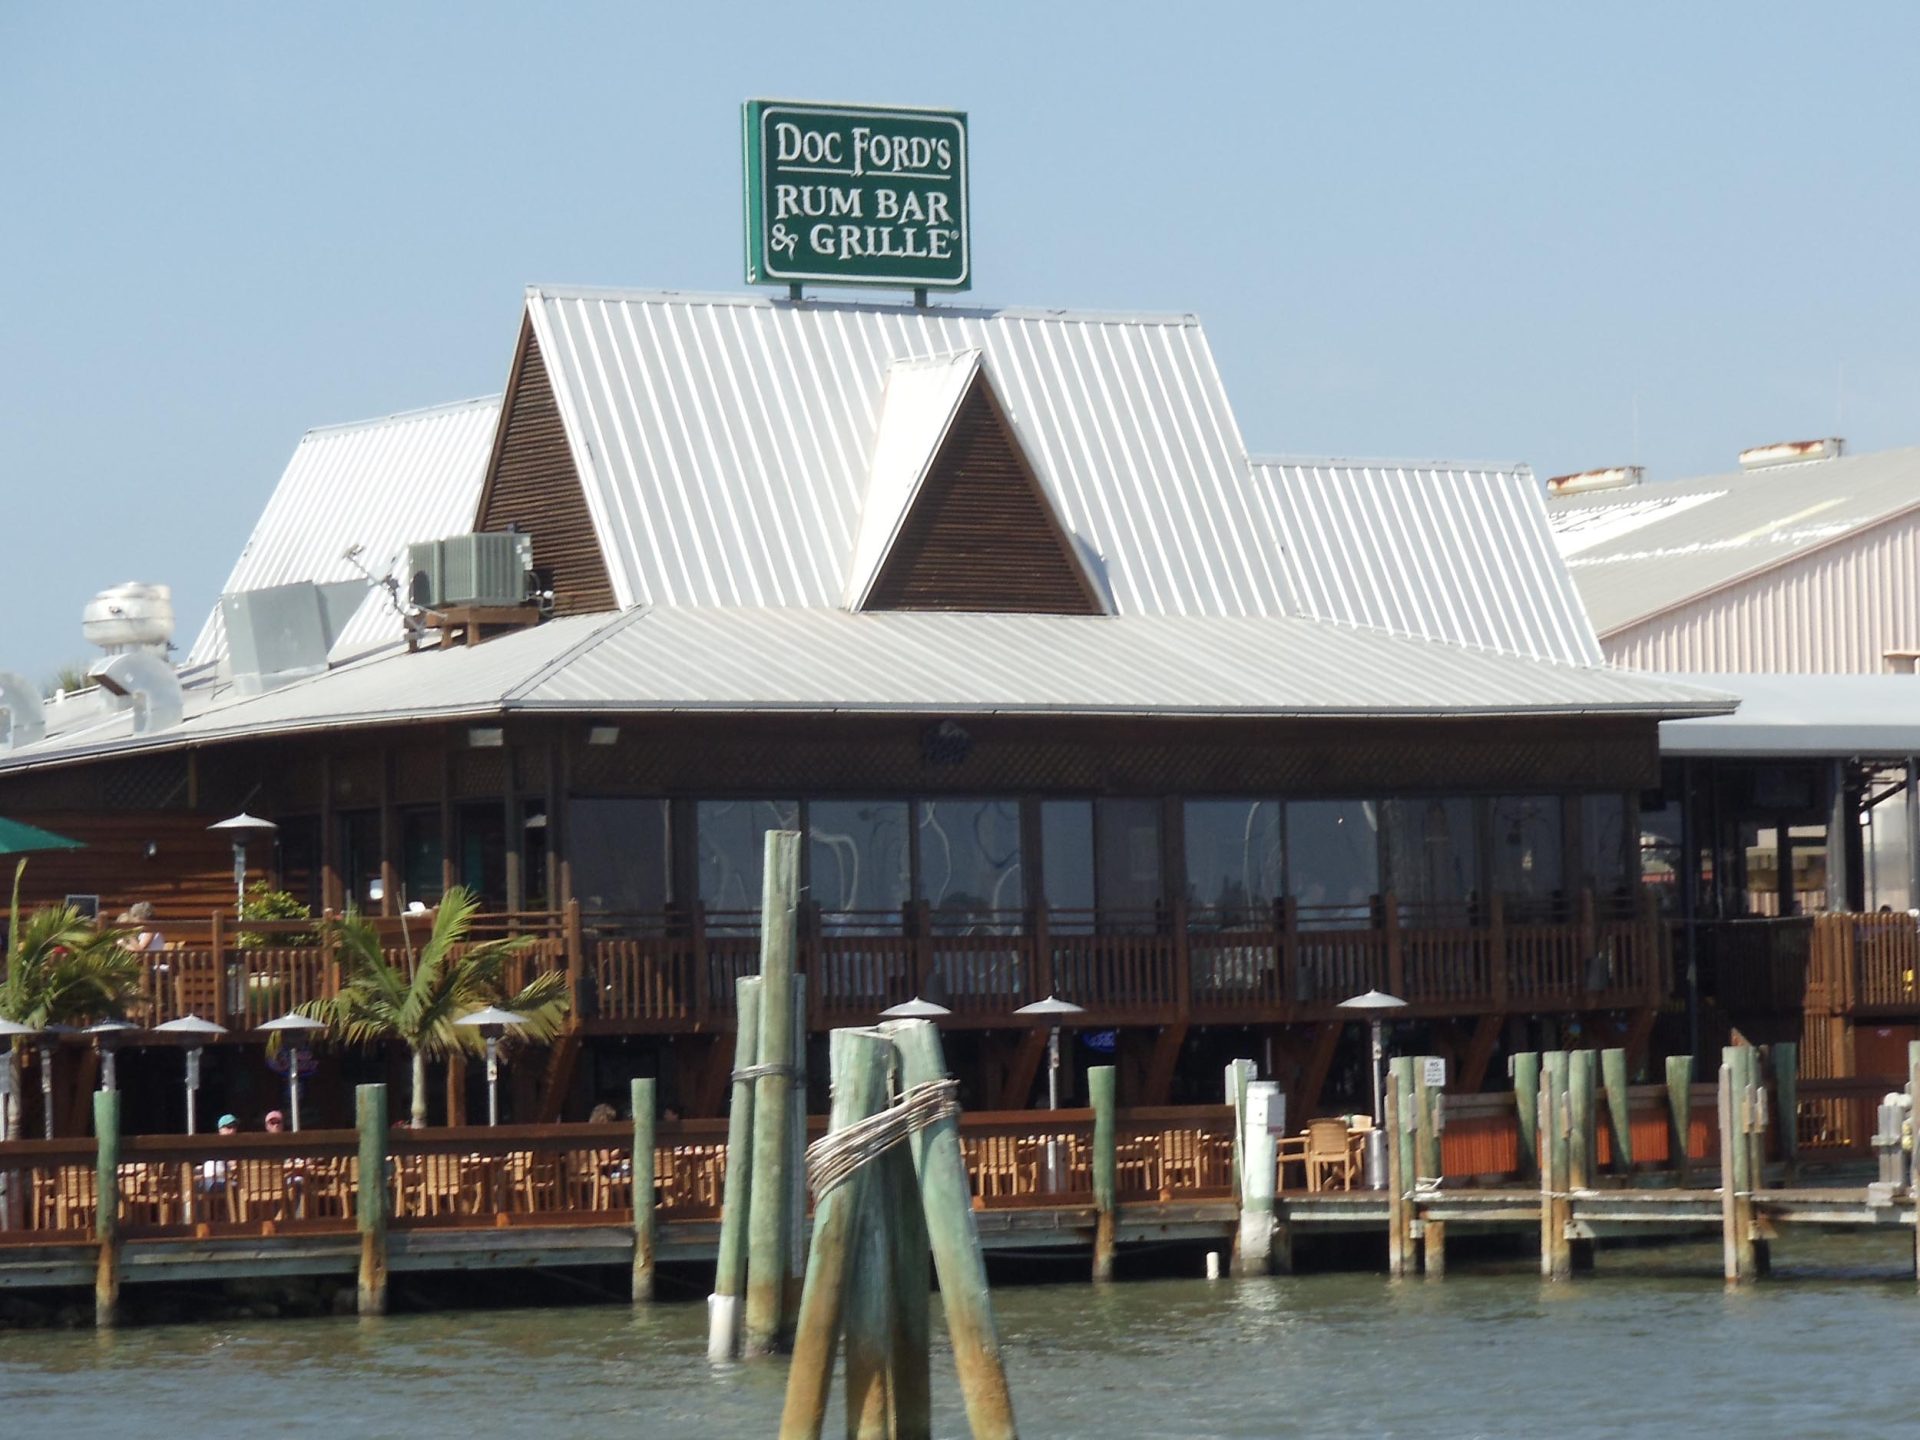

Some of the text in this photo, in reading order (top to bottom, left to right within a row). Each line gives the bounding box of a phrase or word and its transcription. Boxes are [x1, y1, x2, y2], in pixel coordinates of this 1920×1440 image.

[775, 122, 952, 177] DOC FORD'S
[775, 184, 954, 226] RUM BAR
[771, 223, 799, 260] &
